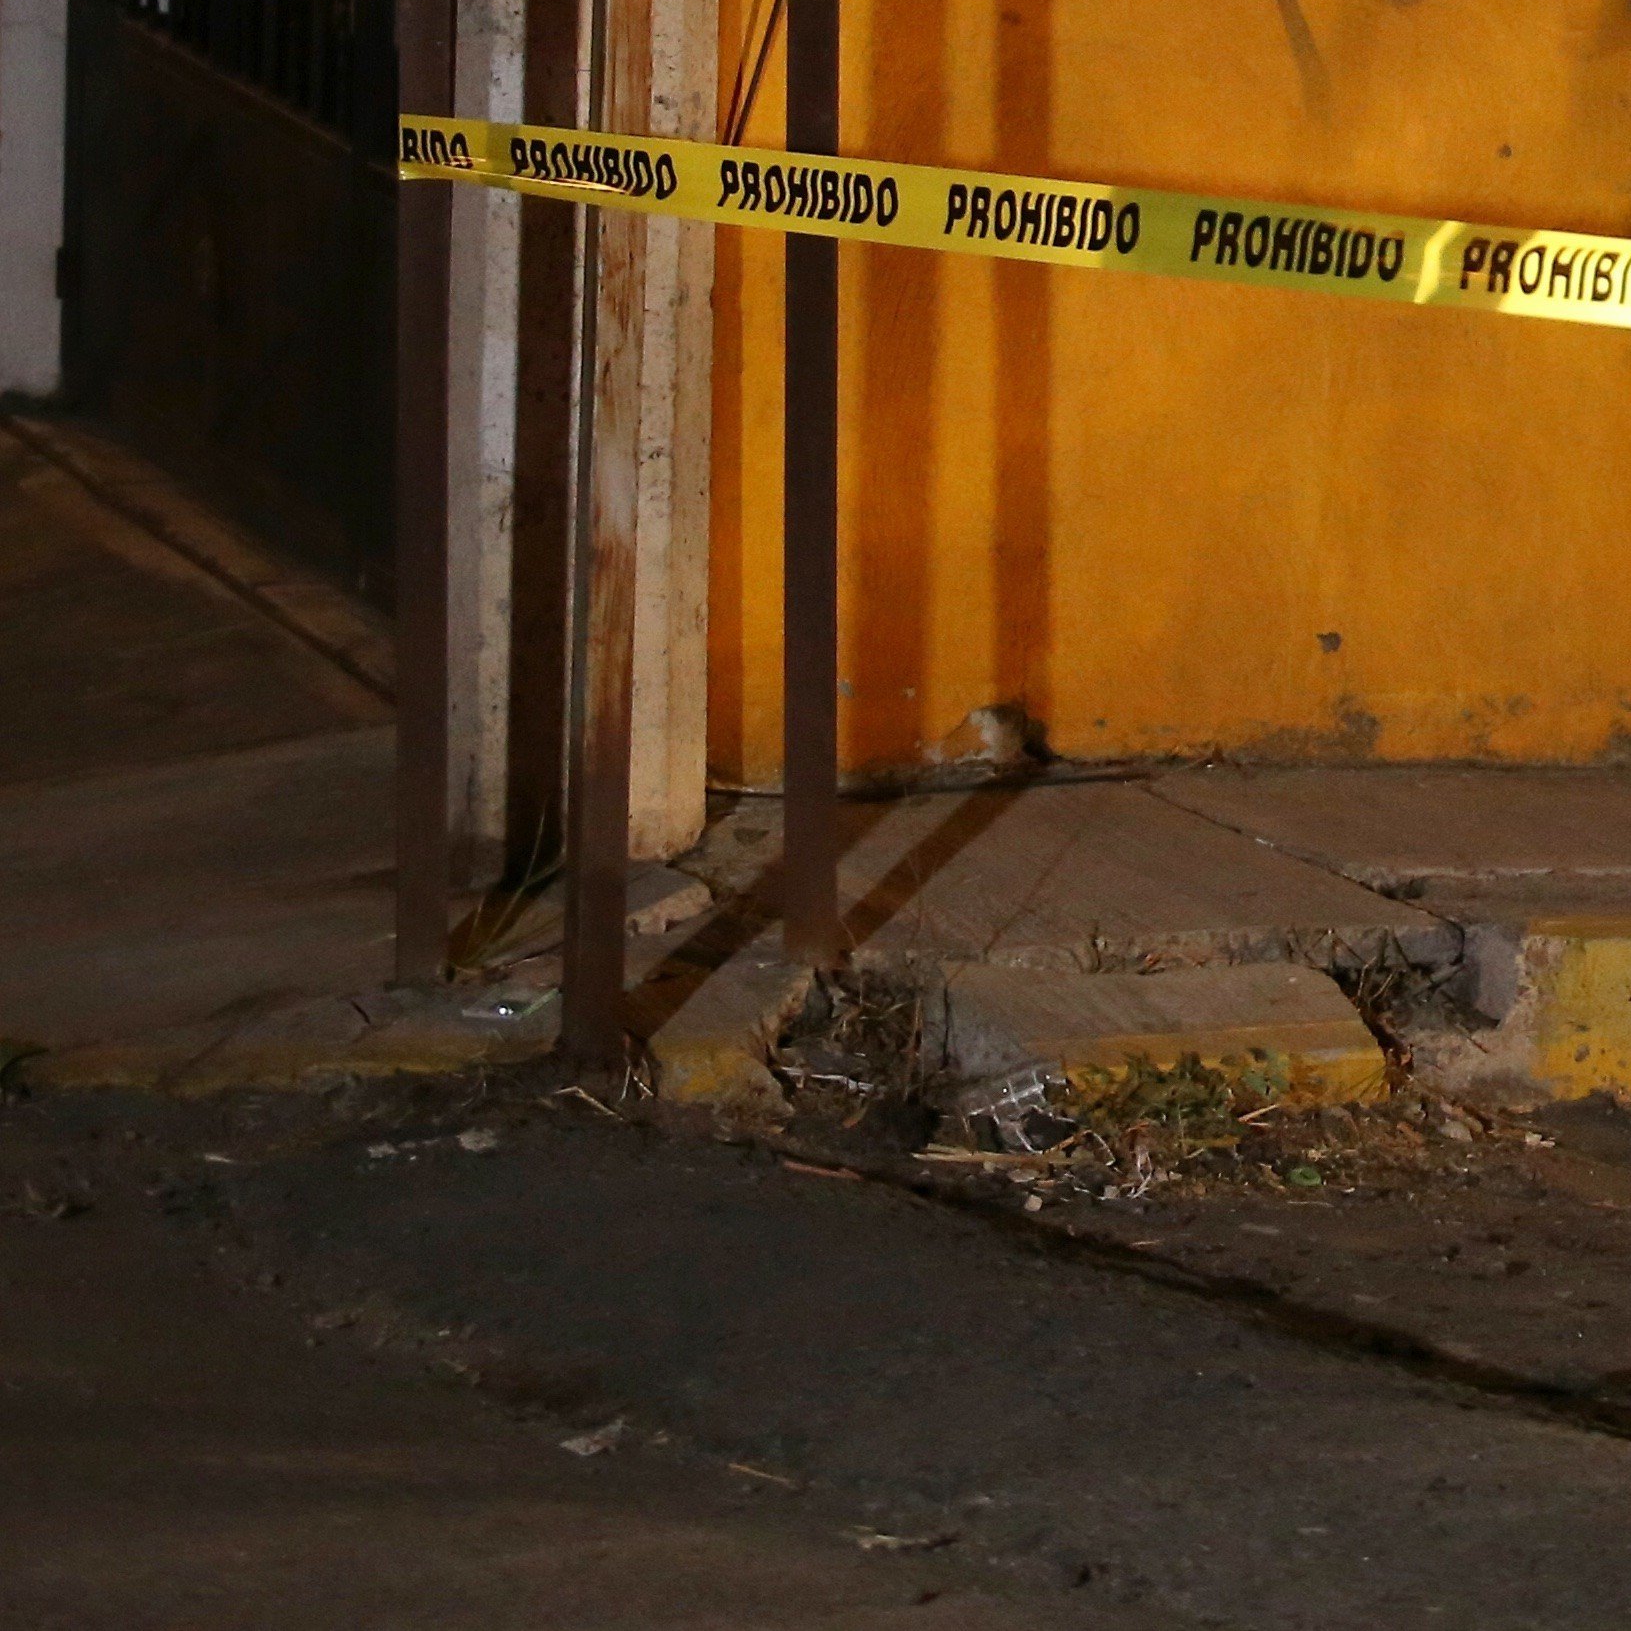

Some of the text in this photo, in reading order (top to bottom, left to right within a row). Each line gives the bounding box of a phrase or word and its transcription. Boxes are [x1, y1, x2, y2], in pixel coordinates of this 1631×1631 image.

[510, 138, 678, 200] PROHIBIDO
[717, 159, 899, 227] PROHIBIDO
[943, 183, 1141, 254] PROHIBIDO
[1190, 209, 1406, 282] PROHIBIDO
